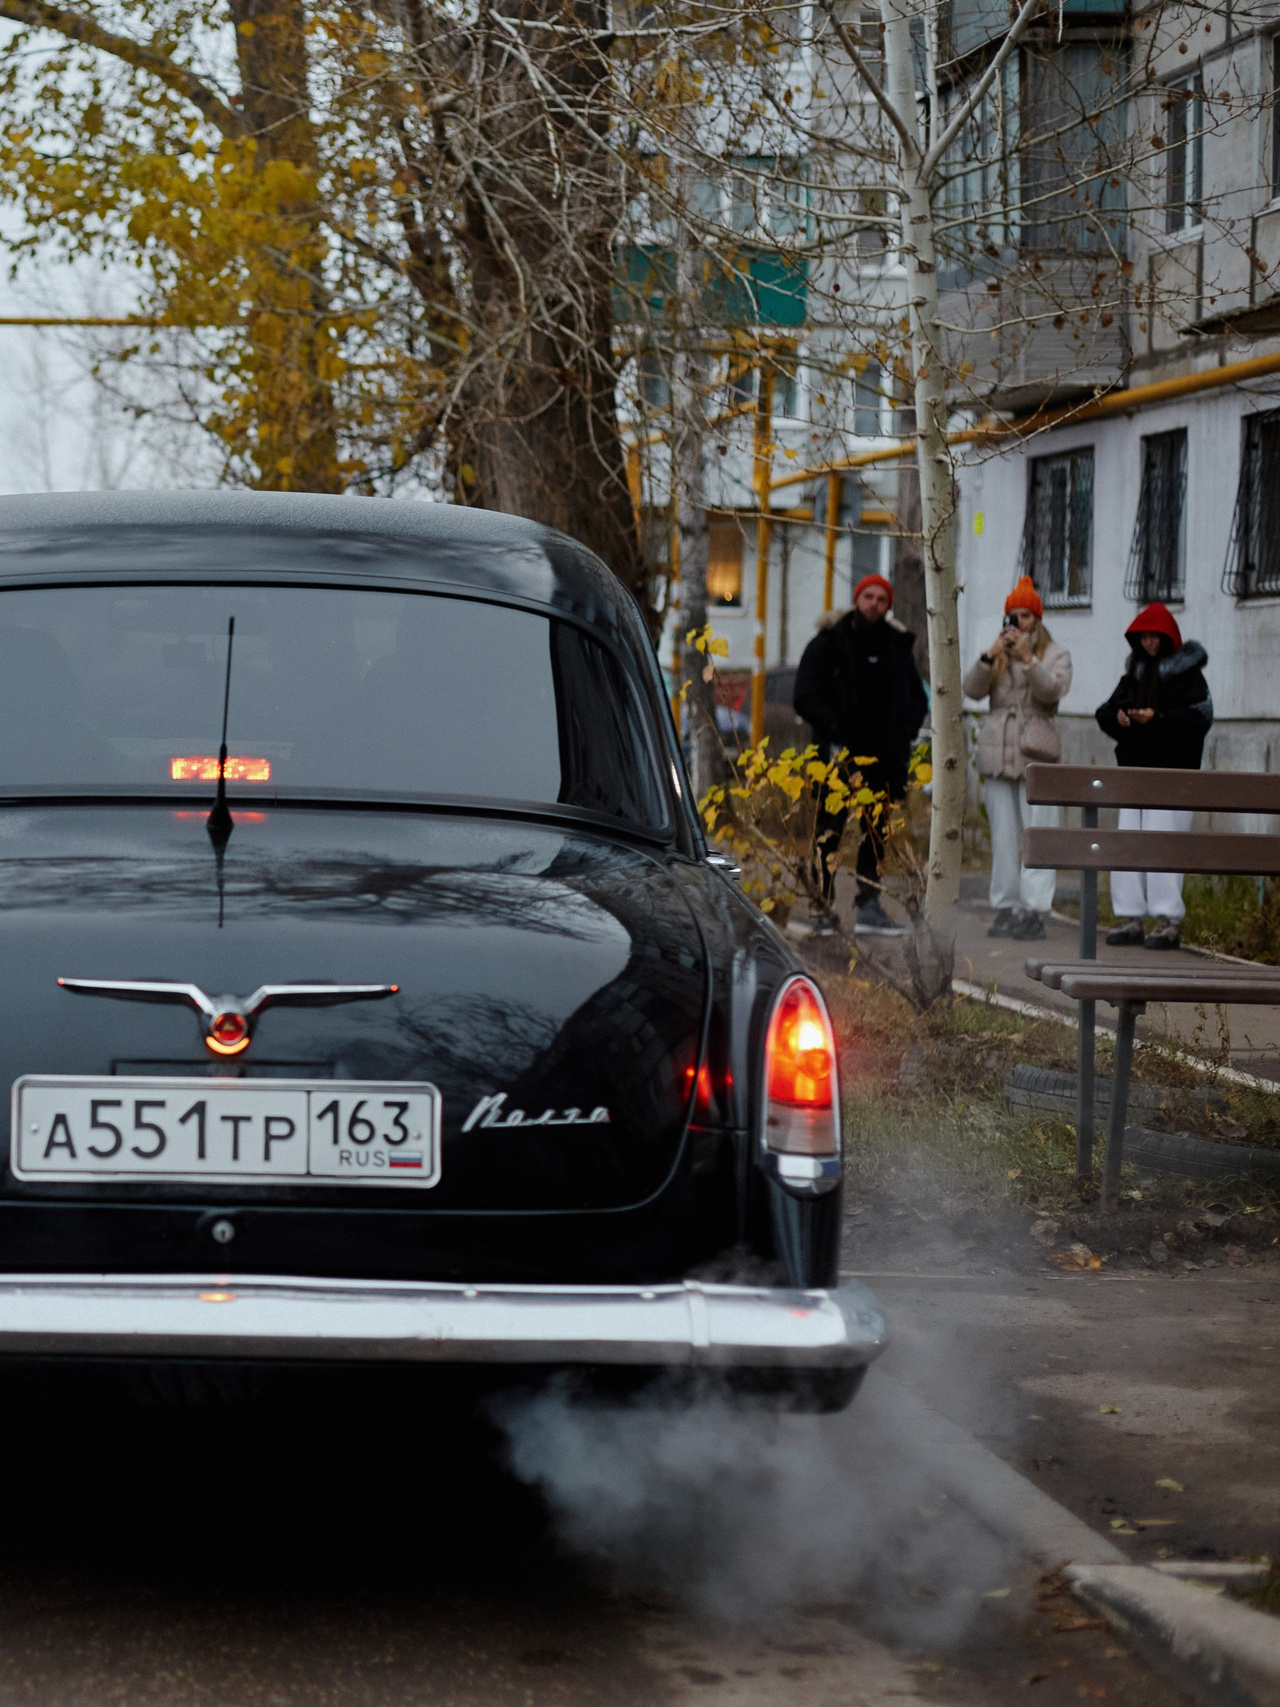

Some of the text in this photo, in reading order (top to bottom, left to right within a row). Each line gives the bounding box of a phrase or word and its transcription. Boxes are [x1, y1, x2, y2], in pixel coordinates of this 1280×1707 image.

[42, 1099, 411, 1162] А551ТР 163
[338, 1149, 387, 1168] RUS
